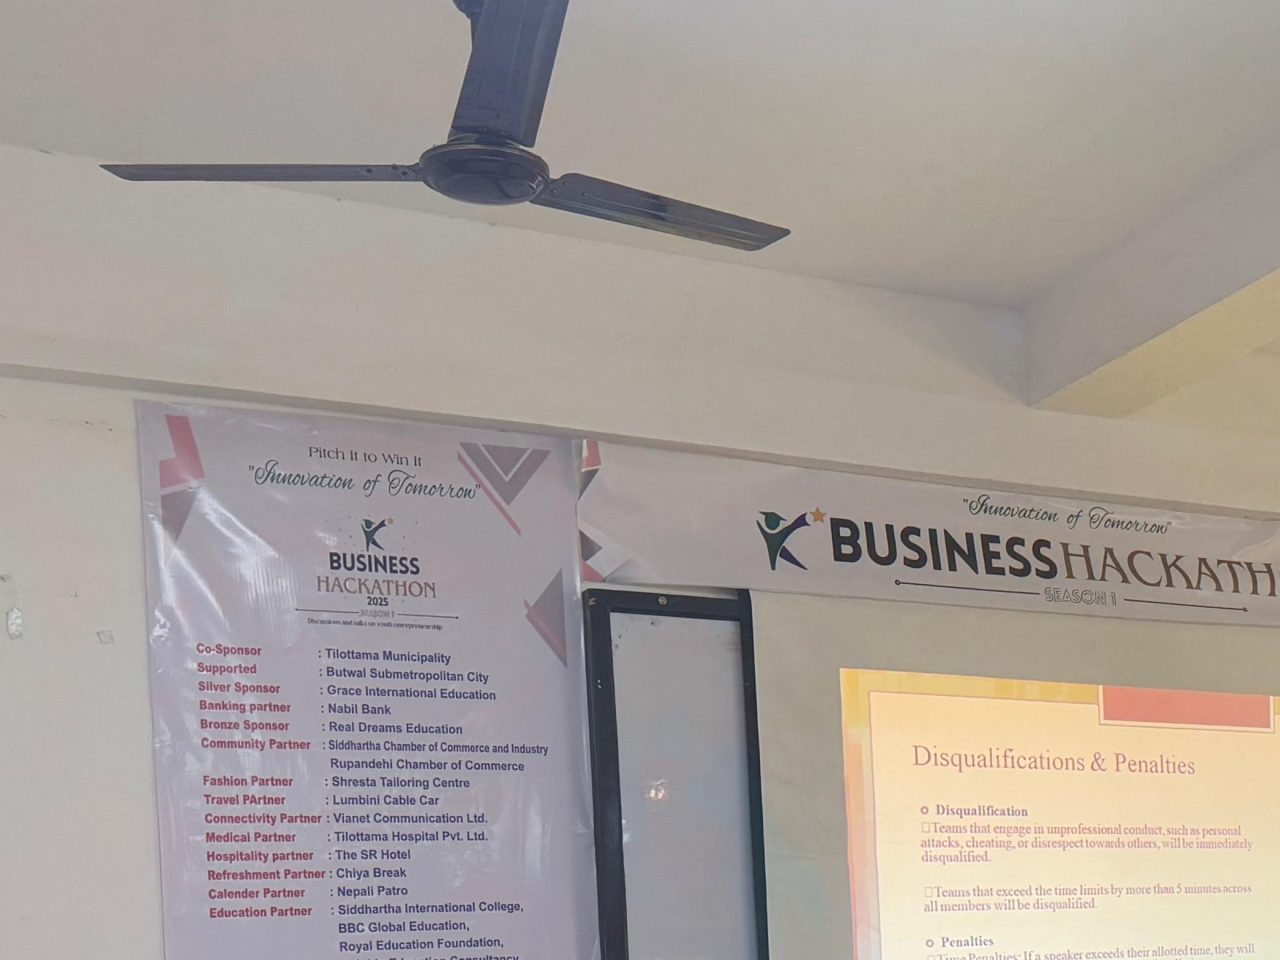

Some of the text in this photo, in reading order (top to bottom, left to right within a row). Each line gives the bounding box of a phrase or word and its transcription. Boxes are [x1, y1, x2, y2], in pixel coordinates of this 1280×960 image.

[308, 446, 422, 468] Pitch It to Win It
[362, 474, 381, 496] of
[1066, 509, 1081, 530] of
[329, 551, 420, 576] BUSINESS
[316, 575, 437, 599] HACKATHON
[367, 596, 389, 607] 2025
[1044, 586, 1104, 605] SEASON
[196, 643, 451, 665] Co-Sponsor Tilottama Municipality
[197, 662, 489, 685] Supported Butwal Submetropolitan City
[198, 681, 496, 701] Silver Sponsor Grace International Education
[199, 700, 392, 715] Banking partner Nabil Bank
[199, 718, 463, 735] Bronze Sponsor Real Dreams Education
[912, 745, 1196, 775] Disqualifications & Penalties
[202, 775, 470, 791] Fashion Partner Shresta Tailoring Centre
[203, 794, 239, 805] Travel
[332, 794, 380, 807] Lumbini
[383, 794, 416, 806] Cable
[419, 794, 439, 806] Car
[936, 804, 1028, 818] Disqualification
[204, 812, 488, 827] Connectivity Partner Vianet Communication Ltd.
[970, 822, 991, 835] that
[993, 824, 1031, 838] engage
[1033, 823, 1044, 835] in
[1047, 823, 1122, 838] unprofessional
[1123, 825, 1165, 838] conduct,
[1167, 825, 1188, 836] such
[1190, 828, 1200, 836] as
[1202, 826, 1242, 838] personal
[921, 851, 992, 865] disqualified.
[923, 897, 1098, 912] all members will be disqualified.
[338, 919, 470, 934] BBC Global Education,
[941, 936, 994, 948] Penalties
